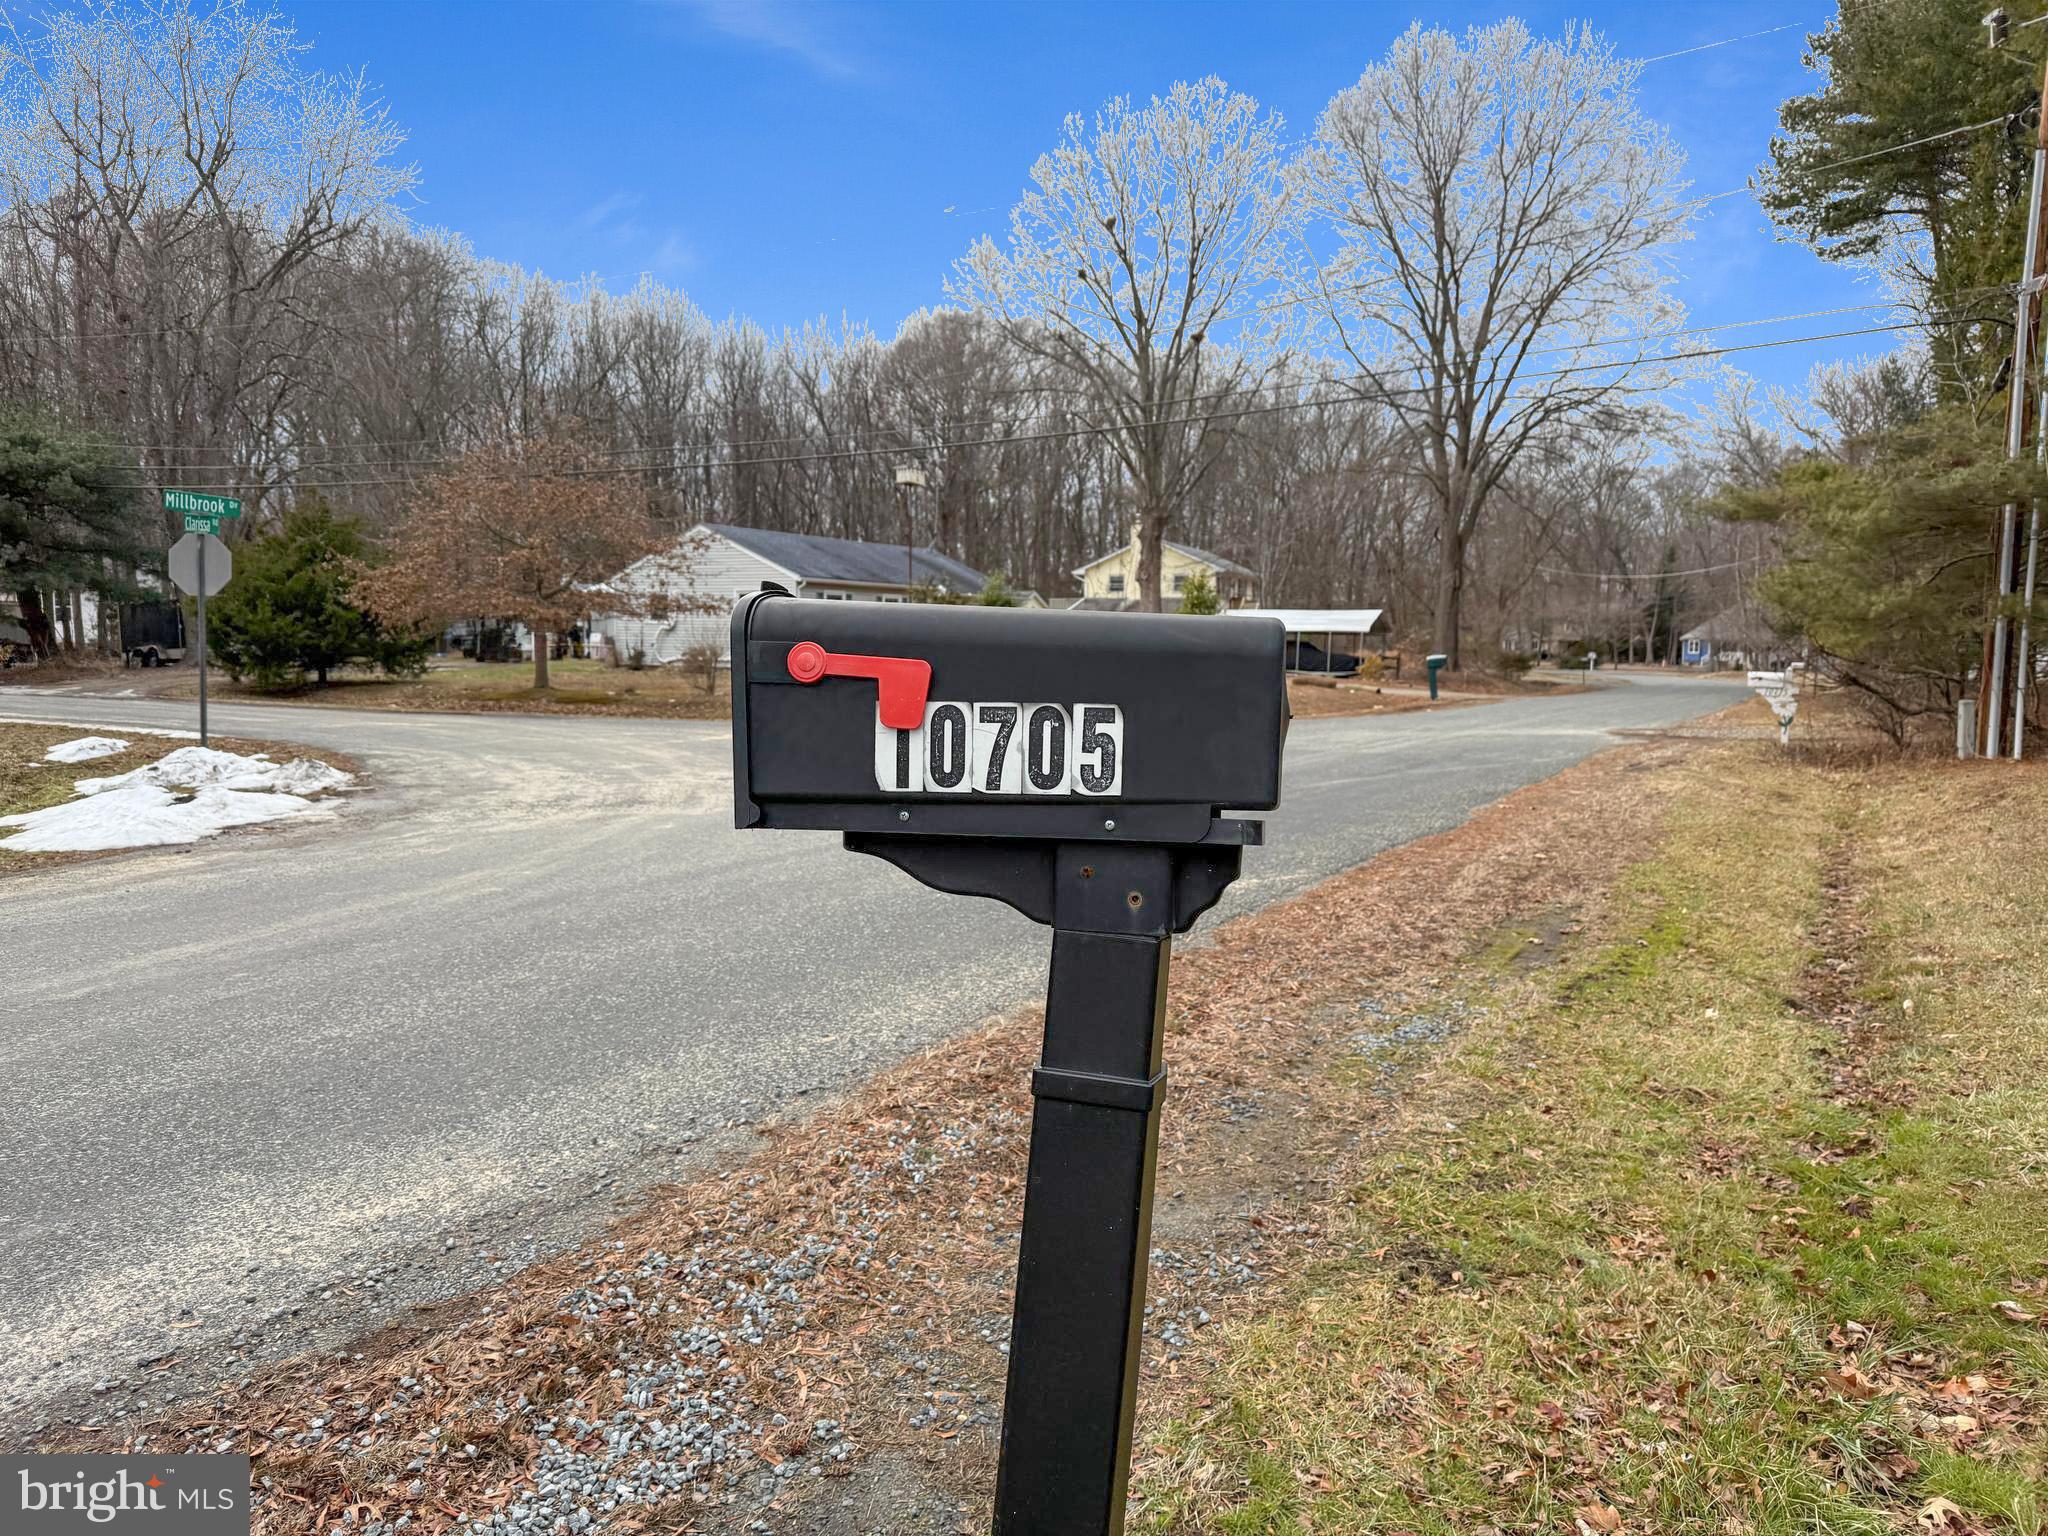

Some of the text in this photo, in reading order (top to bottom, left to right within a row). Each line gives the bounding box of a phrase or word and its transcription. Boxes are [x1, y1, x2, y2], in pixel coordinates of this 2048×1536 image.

[165, 492, 225, 514] Millbrook
[184, 516, 211, 532] Clarissa
[896, 704, 1116, 793] 10705
